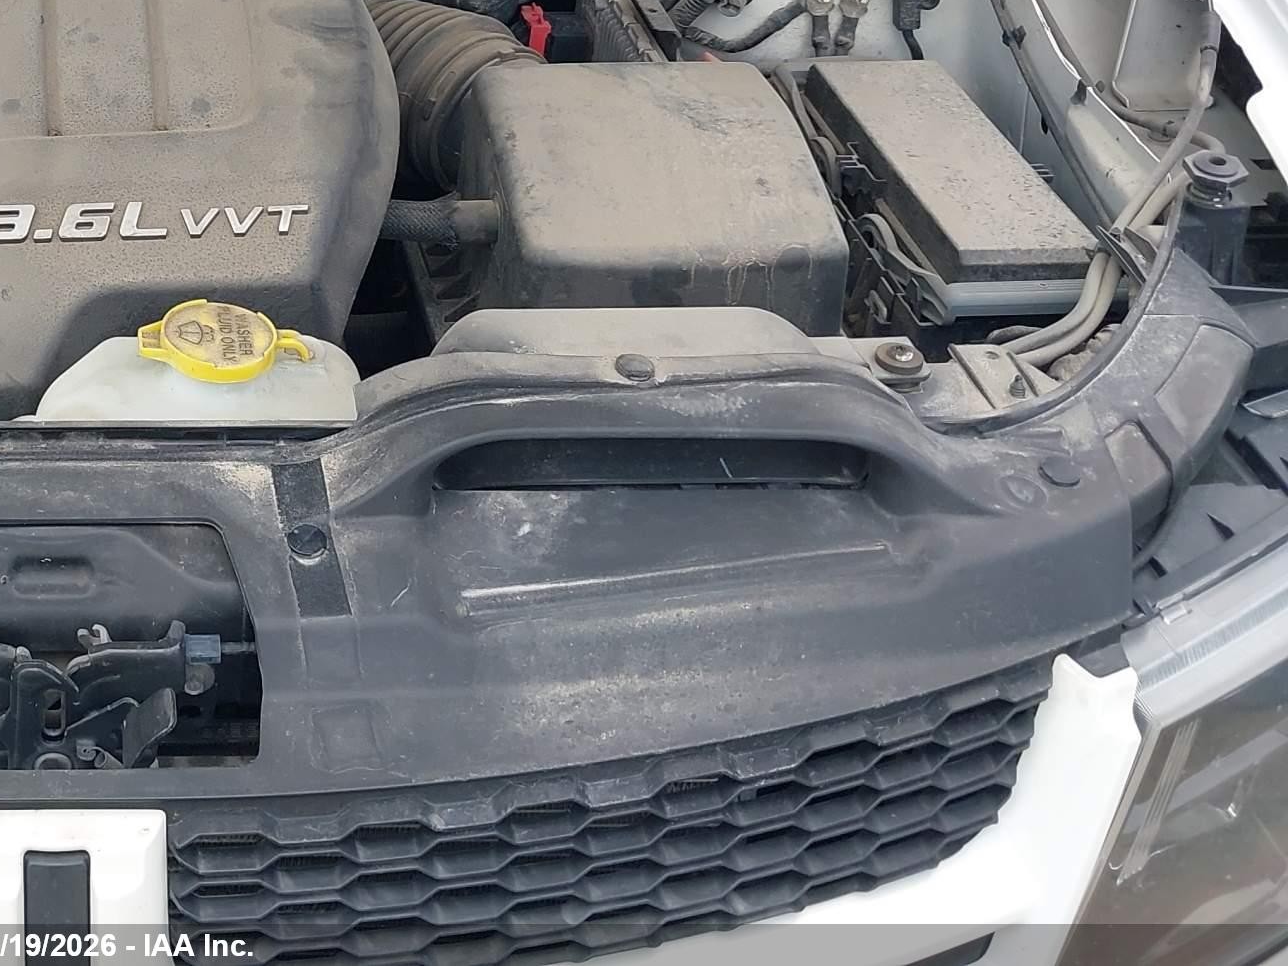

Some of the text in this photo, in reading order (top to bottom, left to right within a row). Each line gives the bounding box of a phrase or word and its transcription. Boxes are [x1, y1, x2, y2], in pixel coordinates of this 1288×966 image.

[180, 204, 309, 237] VVT
[217, 305, 237, 362] FLUID ONLY
[235, 313, 253, 355] WASHER
